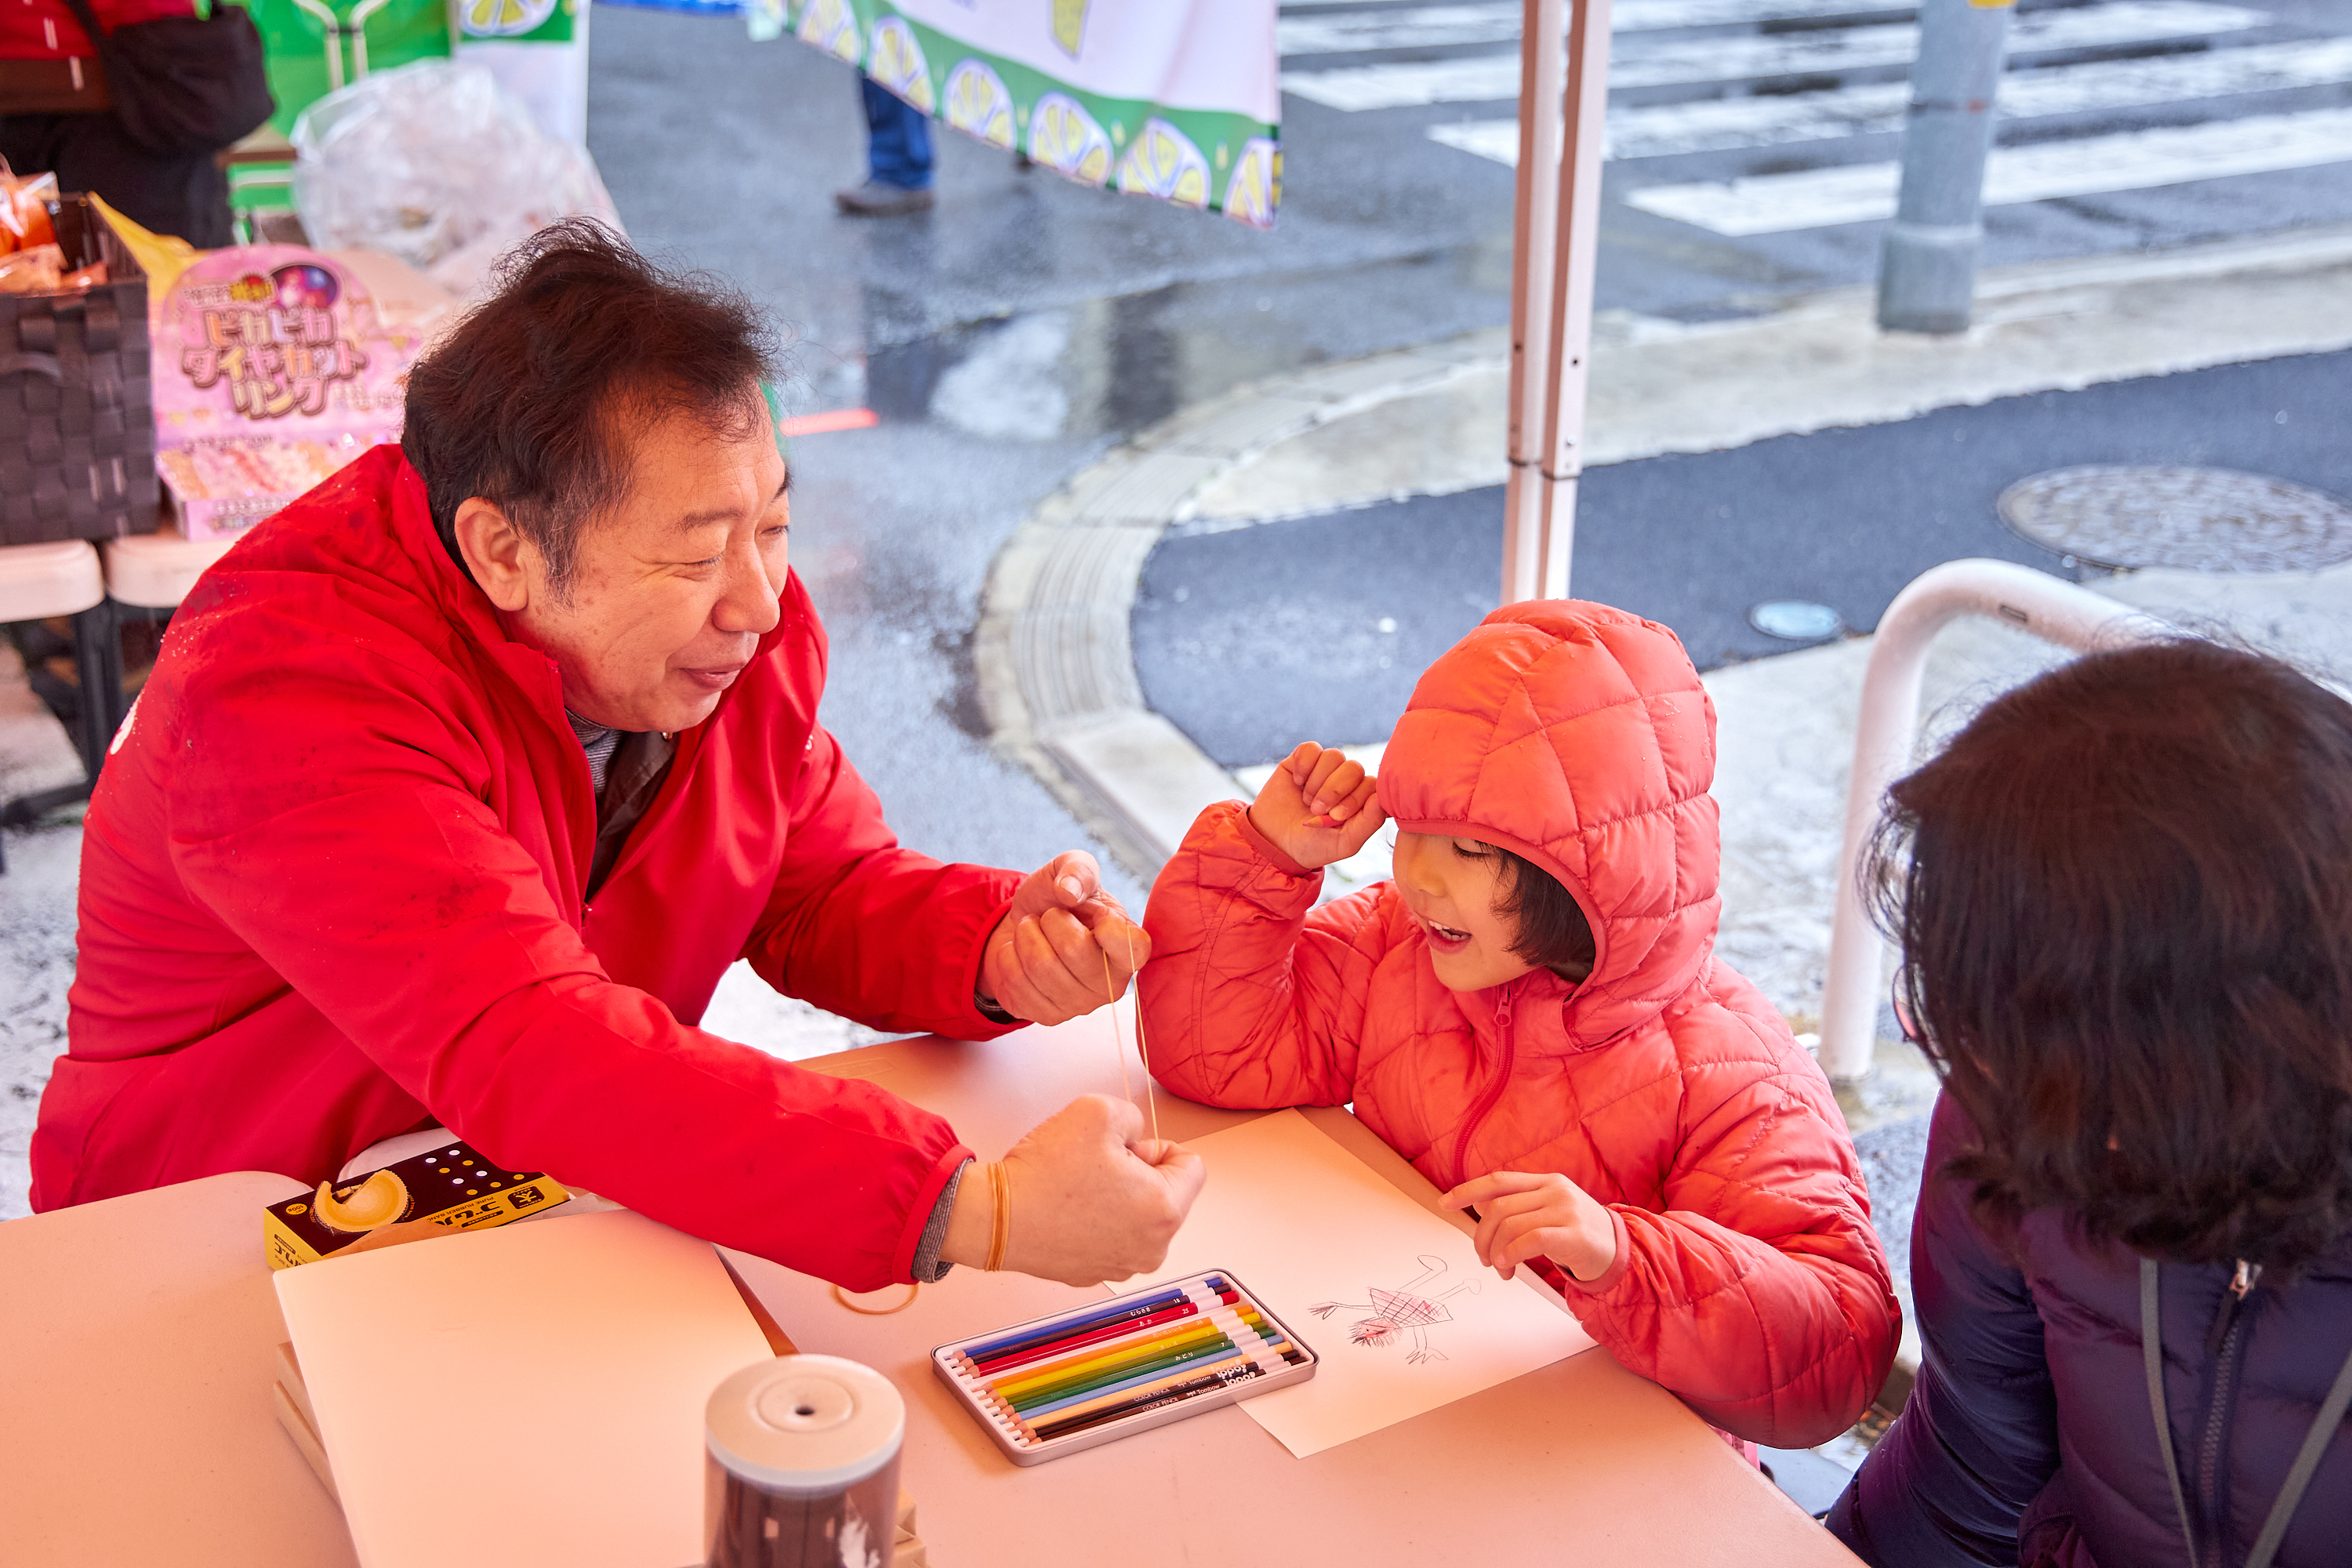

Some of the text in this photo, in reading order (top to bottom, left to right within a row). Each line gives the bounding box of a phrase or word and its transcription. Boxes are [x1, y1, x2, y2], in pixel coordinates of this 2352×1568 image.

[205, 304, 336, 347] ピカピカ
[182, 339, 369, 388] ダイヤカット
[230, 377, 328, 420] リング
[447, 1203, 474, 1215] RUBBER
[515, 1190, 537, 1203] 太
[1130, 1307, 1151, 1316] むらさき
[1175, 1352, 1193, 1361] みどり
[1134, 1393, 1152, 1402] COLOR
[1152, 1388, 1170, 1396] PENCIL
[1189, 1376, 1211, 1385] Tombow
[1217, 1364, 1247, 1379] ippo!
[1142, 1403, 1160, 1411] COLOR
[1161, 1397, 1178, 1406] PENCIL
[1197, 1385, 1220, 1395] Tombow
